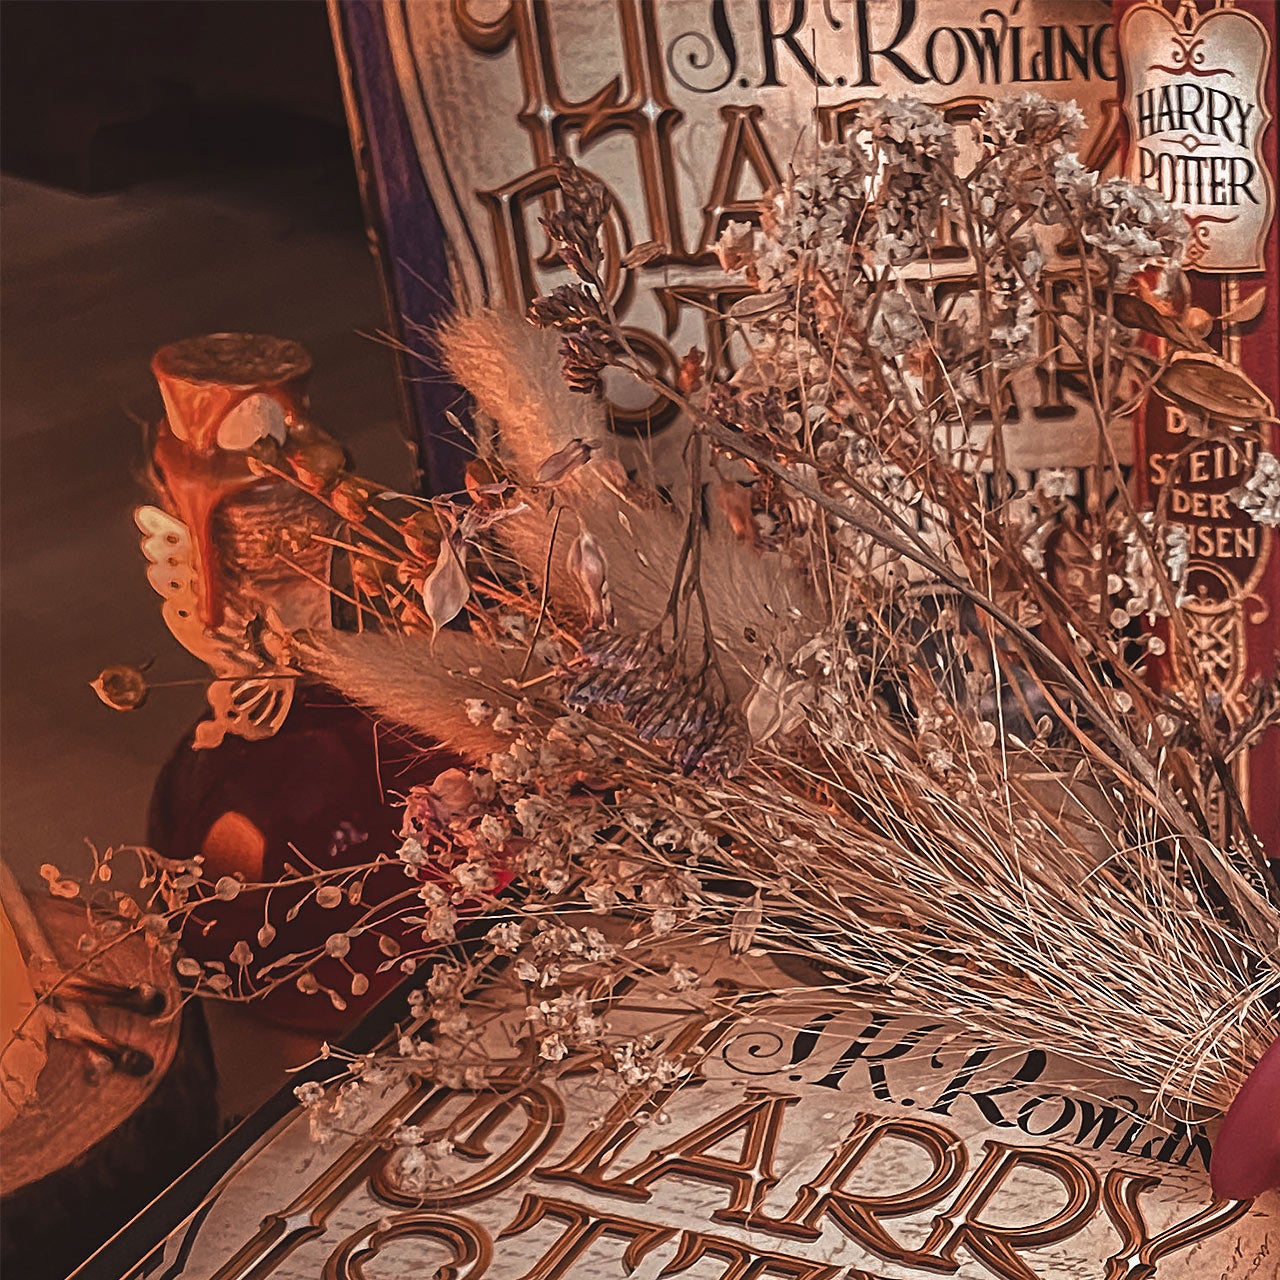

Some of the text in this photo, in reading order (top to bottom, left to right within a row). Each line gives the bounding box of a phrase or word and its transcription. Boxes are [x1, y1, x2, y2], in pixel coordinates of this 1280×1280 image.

[1136, 83, 1255, 149] HARRY
[1139, 146, 1261, 206] POTTER
[1171, 488, 1232, 519] DER
[1187, 523, 1256, 558] ISEN
[925, 1030, 1214, 1174] ROWLIN
